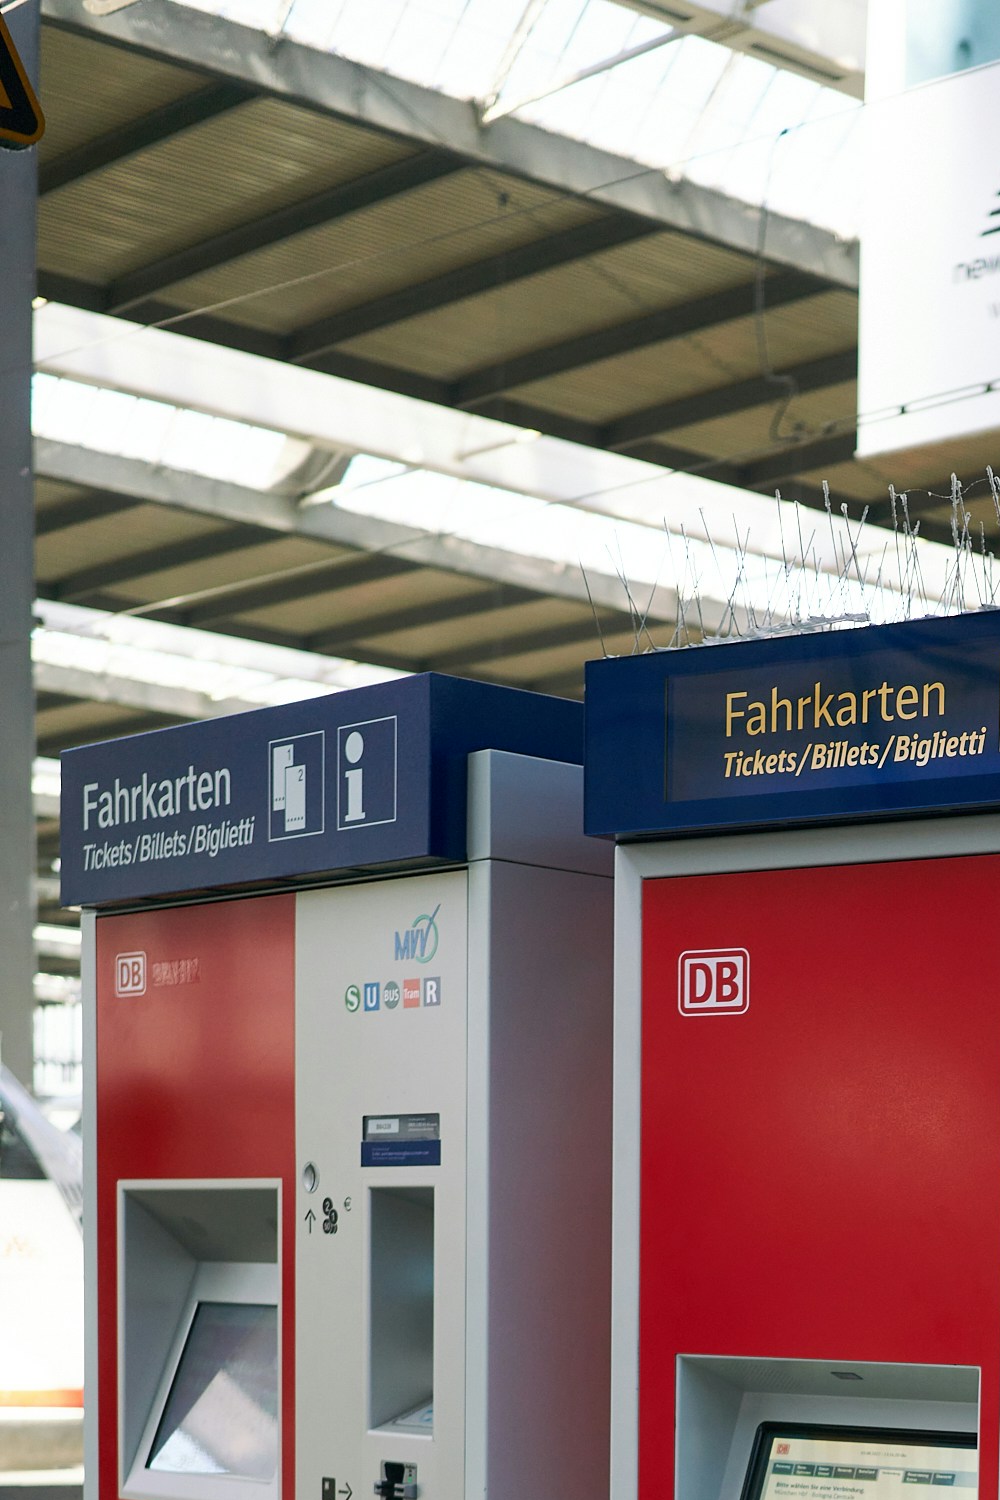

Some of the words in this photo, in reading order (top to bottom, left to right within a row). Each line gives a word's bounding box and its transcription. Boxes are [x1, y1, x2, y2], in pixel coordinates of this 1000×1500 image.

[725, 680, 947, 738] Fahrkarten
[724, 727, 987, 778] Tickets/Billets/Biglietti
[83, 766, 231, 831] Fahrkarten
[83, 816, 255, 872] Tickets/Billets/Biglietti
[119, 957, 143, 992] DB
[384, 988, 400, 1002] BUS
[403, 988, 420, 1000] Tram
[426, 980, 437, 1004] R
[685, 956, 743, 1008] DB
